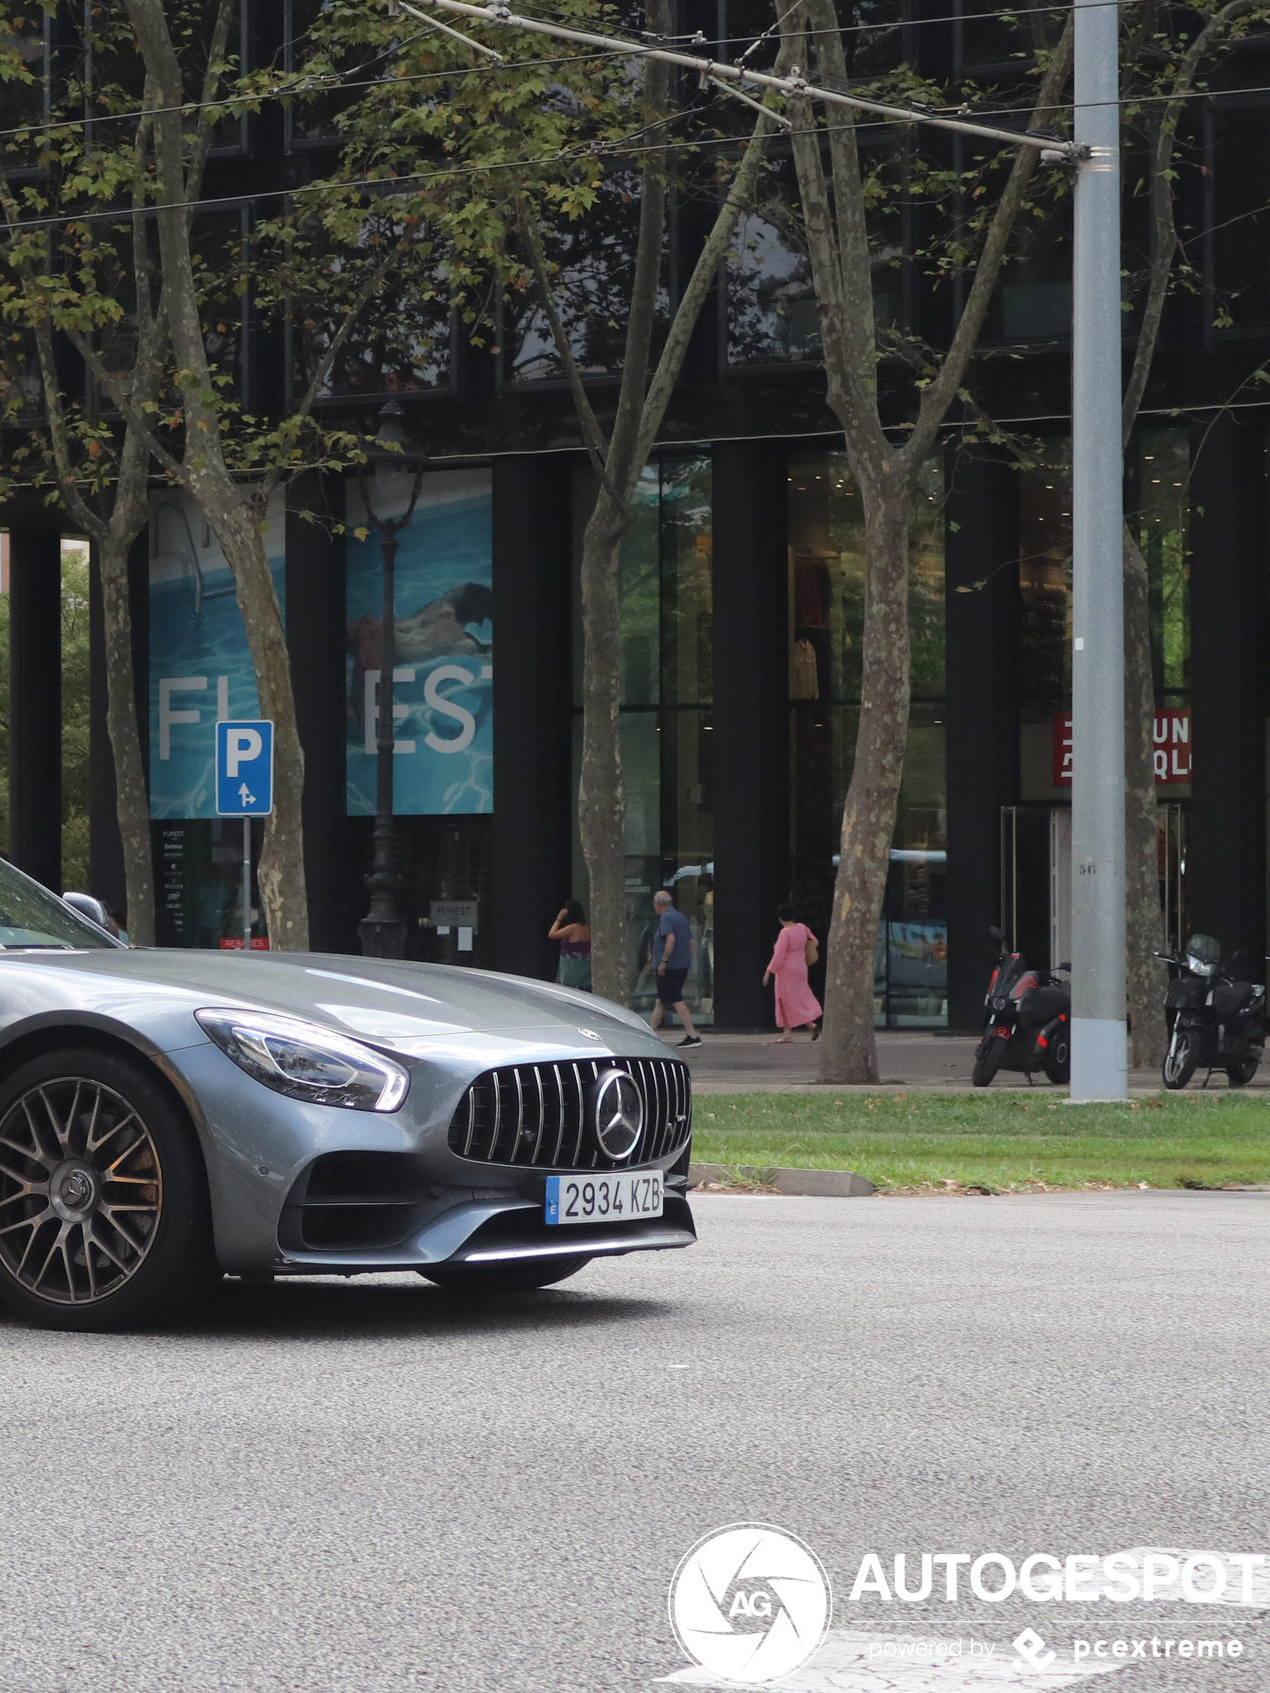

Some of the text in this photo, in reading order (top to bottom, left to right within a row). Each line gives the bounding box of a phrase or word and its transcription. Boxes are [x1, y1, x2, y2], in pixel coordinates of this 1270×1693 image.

[226, 728, 263, 778] P
[1153, 749, 1192, 780] QL
[1079, 864, 1096, 875] 56
[565, 1177, 660, 1217] 2934 KZB
